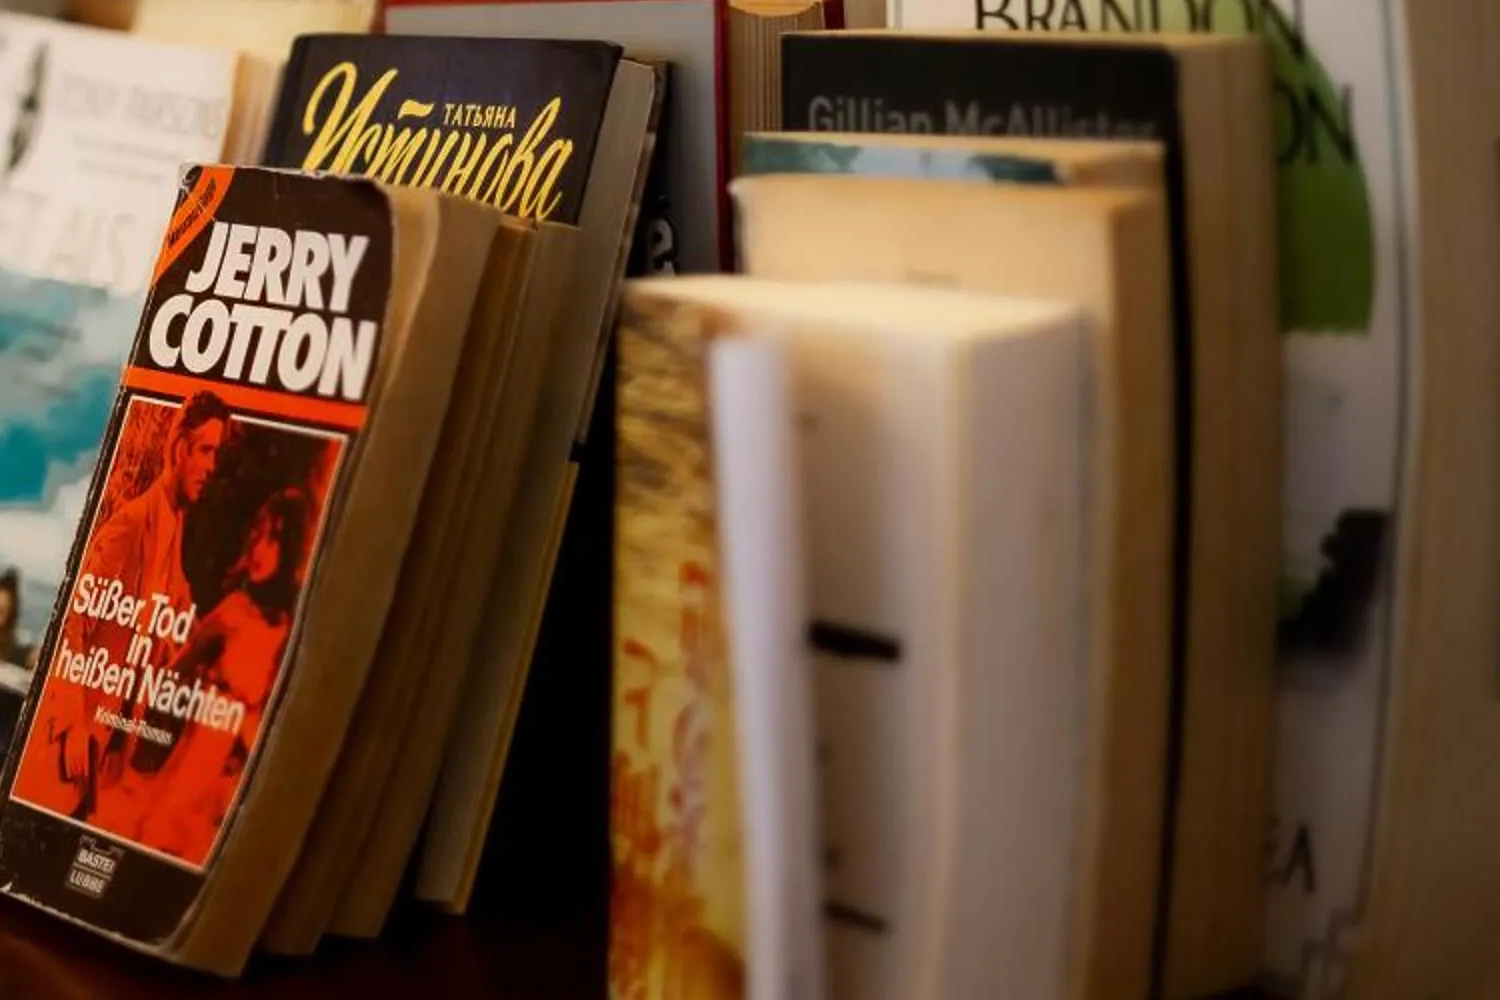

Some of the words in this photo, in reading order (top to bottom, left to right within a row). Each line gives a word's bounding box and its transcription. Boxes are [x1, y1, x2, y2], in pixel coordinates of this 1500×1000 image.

[442, 103, 517, 129] ТАТЬЯНА
[807, 95, 933, 133] Gillian
[185, 221, 370, 313] JERRY
[149, 293, 377, 400] COTTON
[73, 573, 146, 629] Süßer
[148, 592, 197, 644] Tod
[126, 625, 153, 668] in
[56, 638, 136, 700] heißen
[136, 664, 245, 735] Nächten
